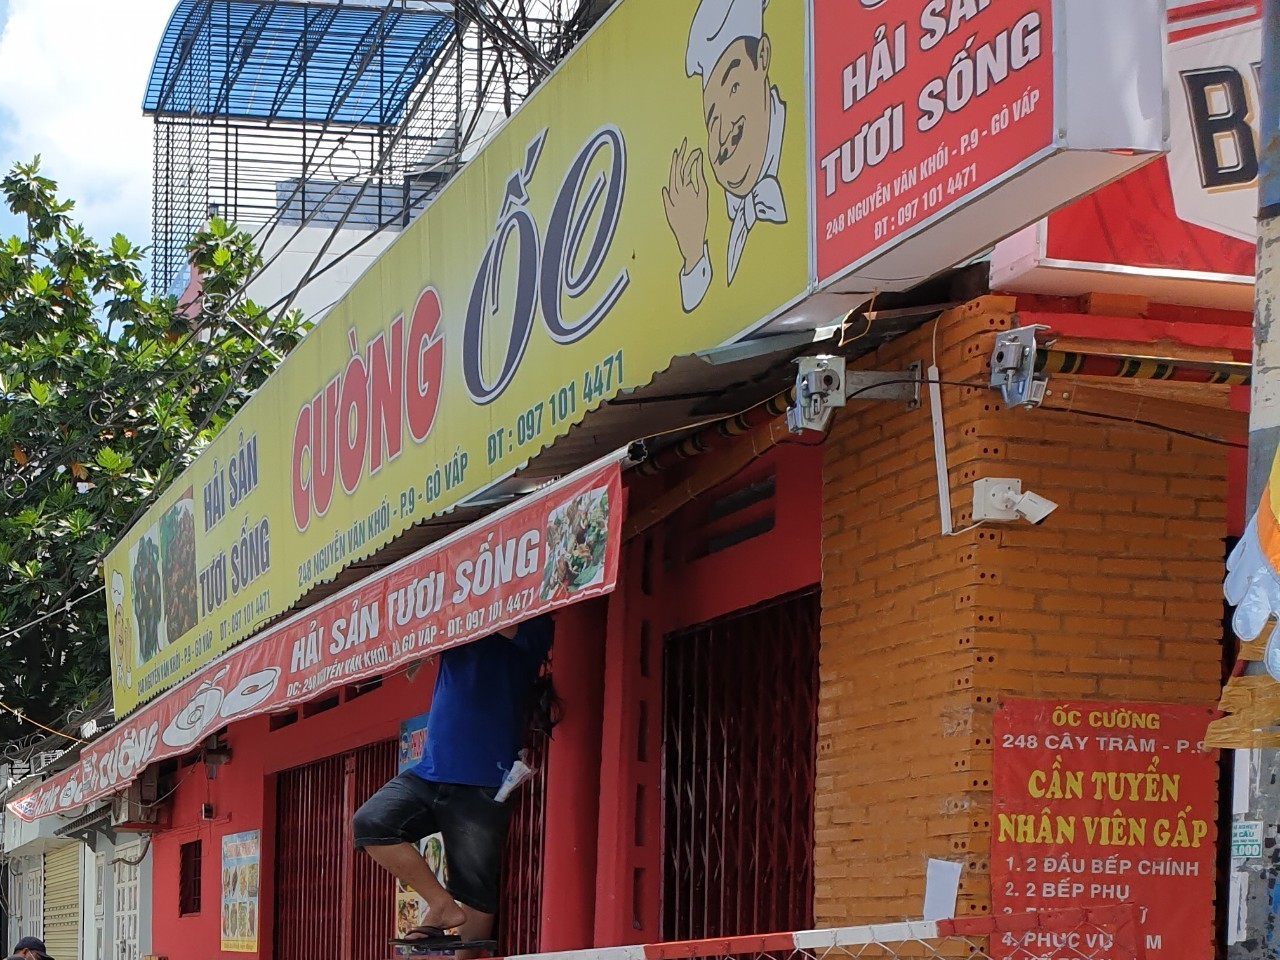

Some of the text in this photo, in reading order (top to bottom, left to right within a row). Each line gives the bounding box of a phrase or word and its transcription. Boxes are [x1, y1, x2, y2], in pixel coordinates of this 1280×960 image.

[820, 11, 1042, 198] TƯƠI SỐNG
[842, 23, 907, 112] HẢI
[826, 215, 845, 241] 248
[847, 180, 891, 227] NGUYỄN
[893, 169, 917, 199] VĂN
[960, 128, 979, 156] P.9
[990, 104, 1010, 136] GÒ
[1012, 86, 1040, 122] VẤP
[1178, 63, 1262, 191] B
[897, 199, 918, 226] 097
[922, 183, 943, 211] 101
[946, 162, 977, 195] 4471
[291, 285, 445, 533] CƯỜNG
[202, 429, 258, 534] HẢI SẢN
[297, 348, 624, 588] 248 NGUYỄN VĂN KHỐI P.9 GÒ VẤP ĐT 097 101 4471
[198, 514, 271, 619] TƯƠI SỐNG
[290, 529, 541, 674] HẢI SẢN TƯƠI SỐNG
[466, 606, 484, 631] 097
[488, 599, 502, 623] 101
[506, 586, 535, 614] 4471
[1002, 734, 1038, 750] 248
[1044, 733, 1089, 751] CÂY
[1096, 736, 1155, 752] TRÂM
[1052, 704, 1161, 730] ỐC CƯỜNG
[1027, 753, 1181, 803] CẦN TUYỂN
[997, 805, 1209, 848] NHÂN VIÊN GẤP
[1006, 851, 1200, 877] 1. 2 ĐẦU BẾP CHÍNH
[1005, 876, 1131, 902] 2. 2 BẾP PHỤ
